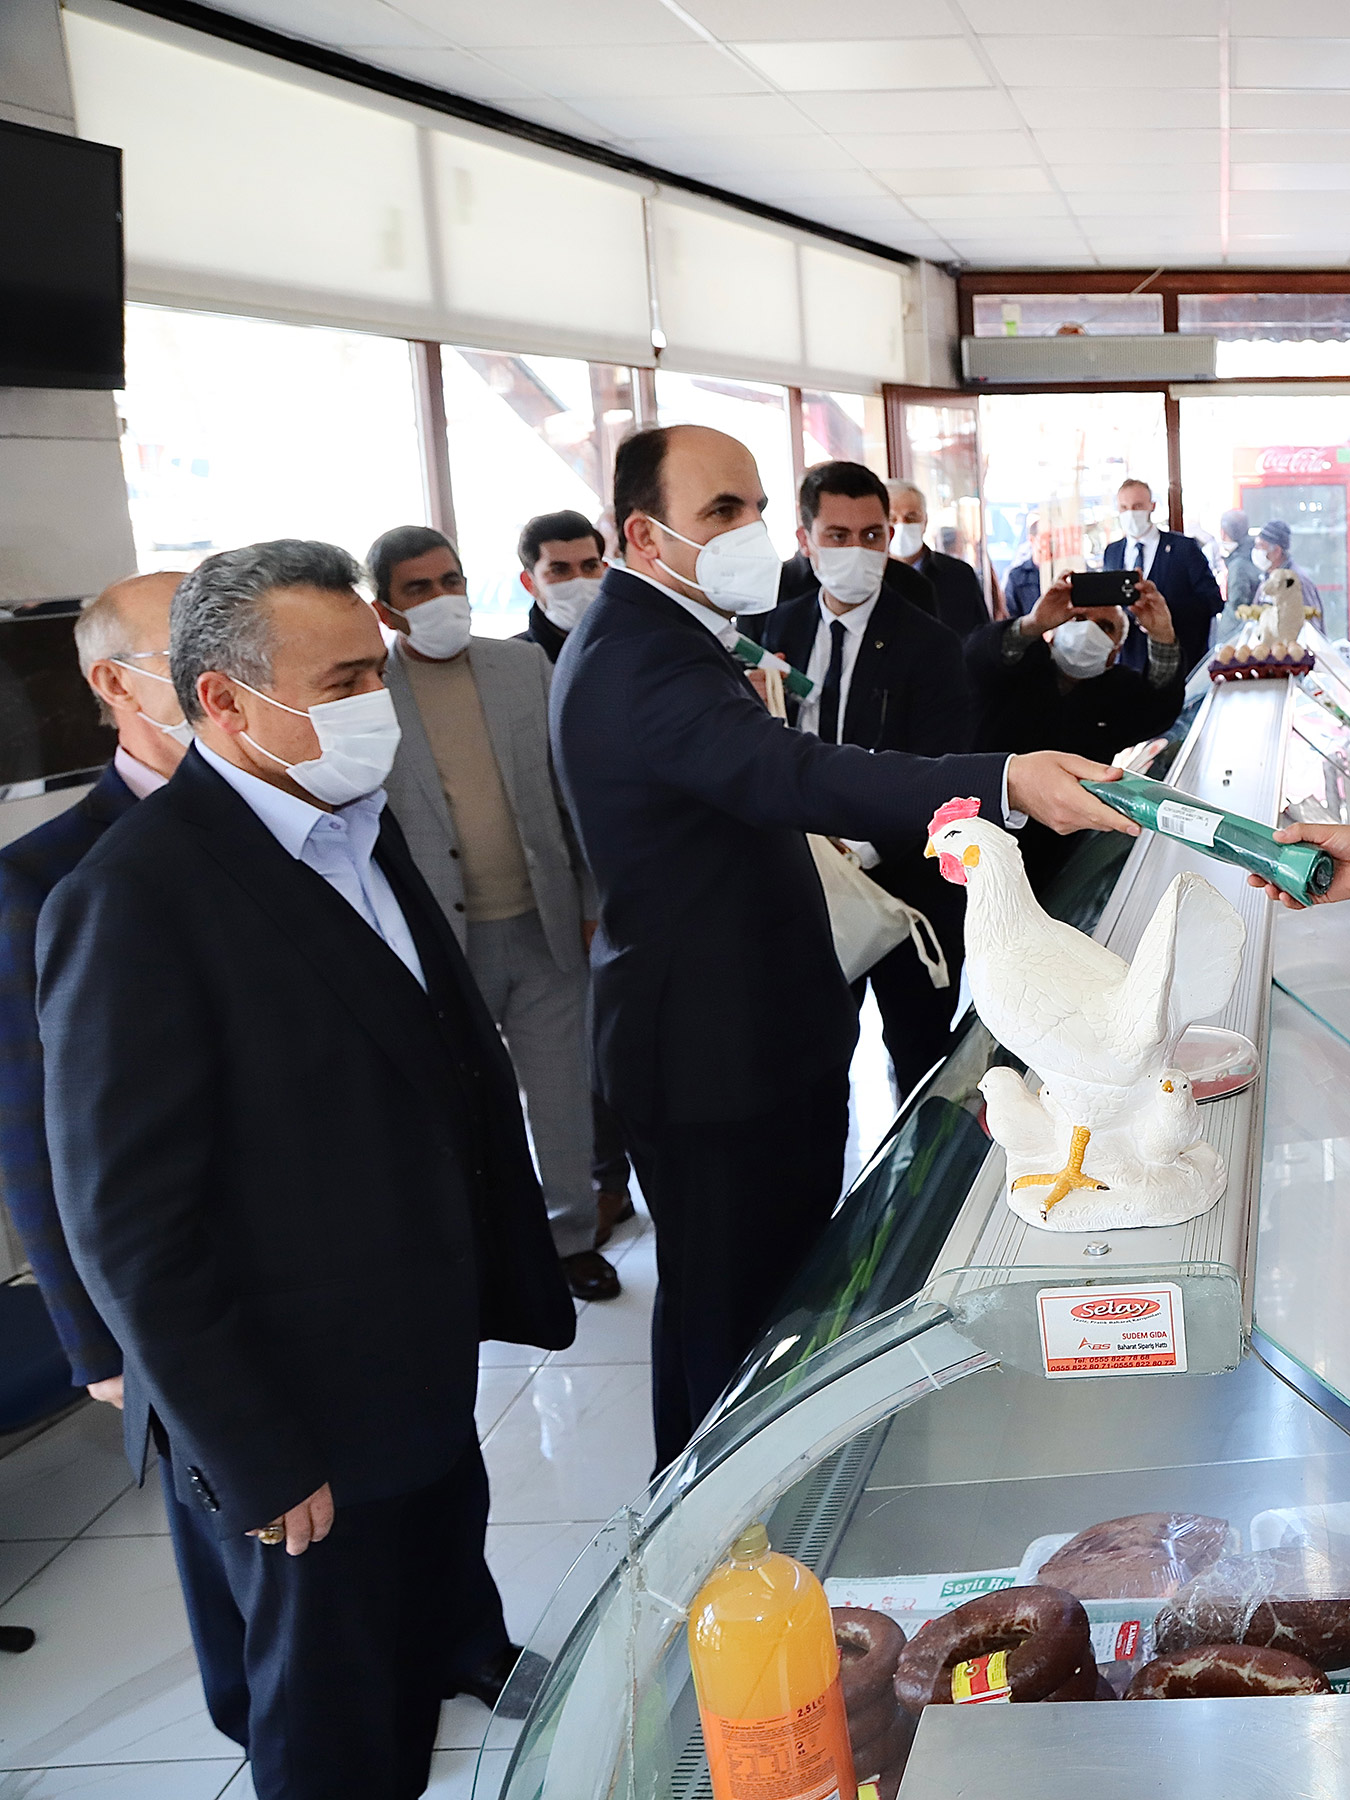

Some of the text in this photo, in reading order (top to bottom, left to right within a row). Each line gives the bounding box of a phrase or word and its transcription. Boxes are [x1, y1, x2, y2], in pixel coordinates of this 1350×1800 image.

[1255, 447, 1328, 474] Coca-Cola
[1080, 1300, 1150, 1318] Selay
[1122, 1331, 1167, 1340] SUDEM GIDA
[1117, 1343, 1137, 1351] Baharat
[944, 1578, 1015, 1594] Seyit Ha
